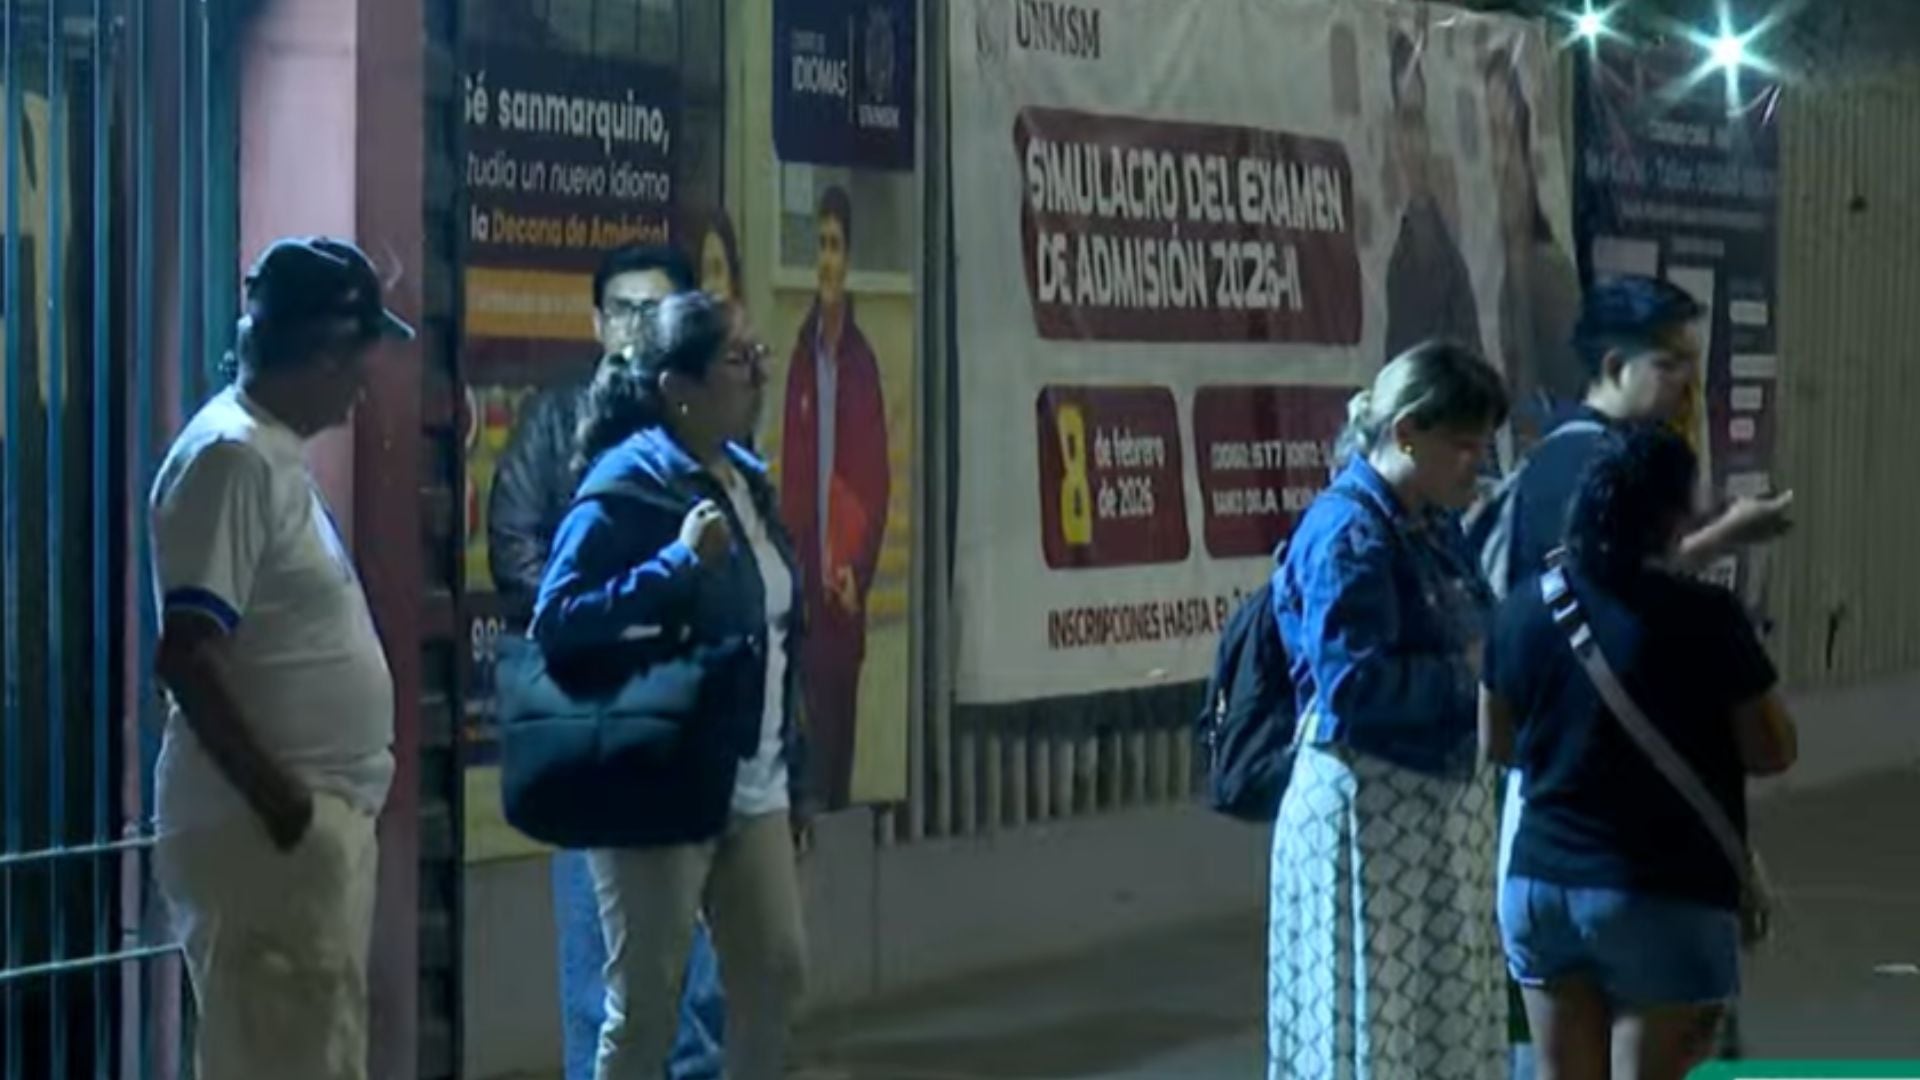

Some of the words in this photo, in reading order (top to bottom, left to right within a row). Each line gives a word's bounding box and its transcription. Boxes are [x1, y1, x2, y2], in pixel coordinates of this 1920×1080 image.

[1015, 0, 1101, 60] UNMSM
[498, 87, 671, 156] sanmarquino,
[521, 160, 546, 193] un
[550, 162, 606, 198] nuevo
[609, 160, 671, 203] idioma
[1026, 137, 1178, 222] SIMULACRO
[1182, 153, 1236, 224] DEL
[1237, 158, 1345, 233] EXAMEN
[471, 203, 490, 242] la
[492, 207, 562, 246] Decana
[565, 213, 588, 246] de
[1037, 229, 1073, 304] DE
[1076, 222, 1208, 308] ADMISIÓN
[1057, 402, 1094, 545] 8
[1094, 426, 1112, 469] de
[1112, 427, 1166, 470] febrero
[1098, 477, 1116, 519] de
[1048, 600, 1161, 650] INSCRIPCIONES
[1162, 597, 1214, 639] HASTA
